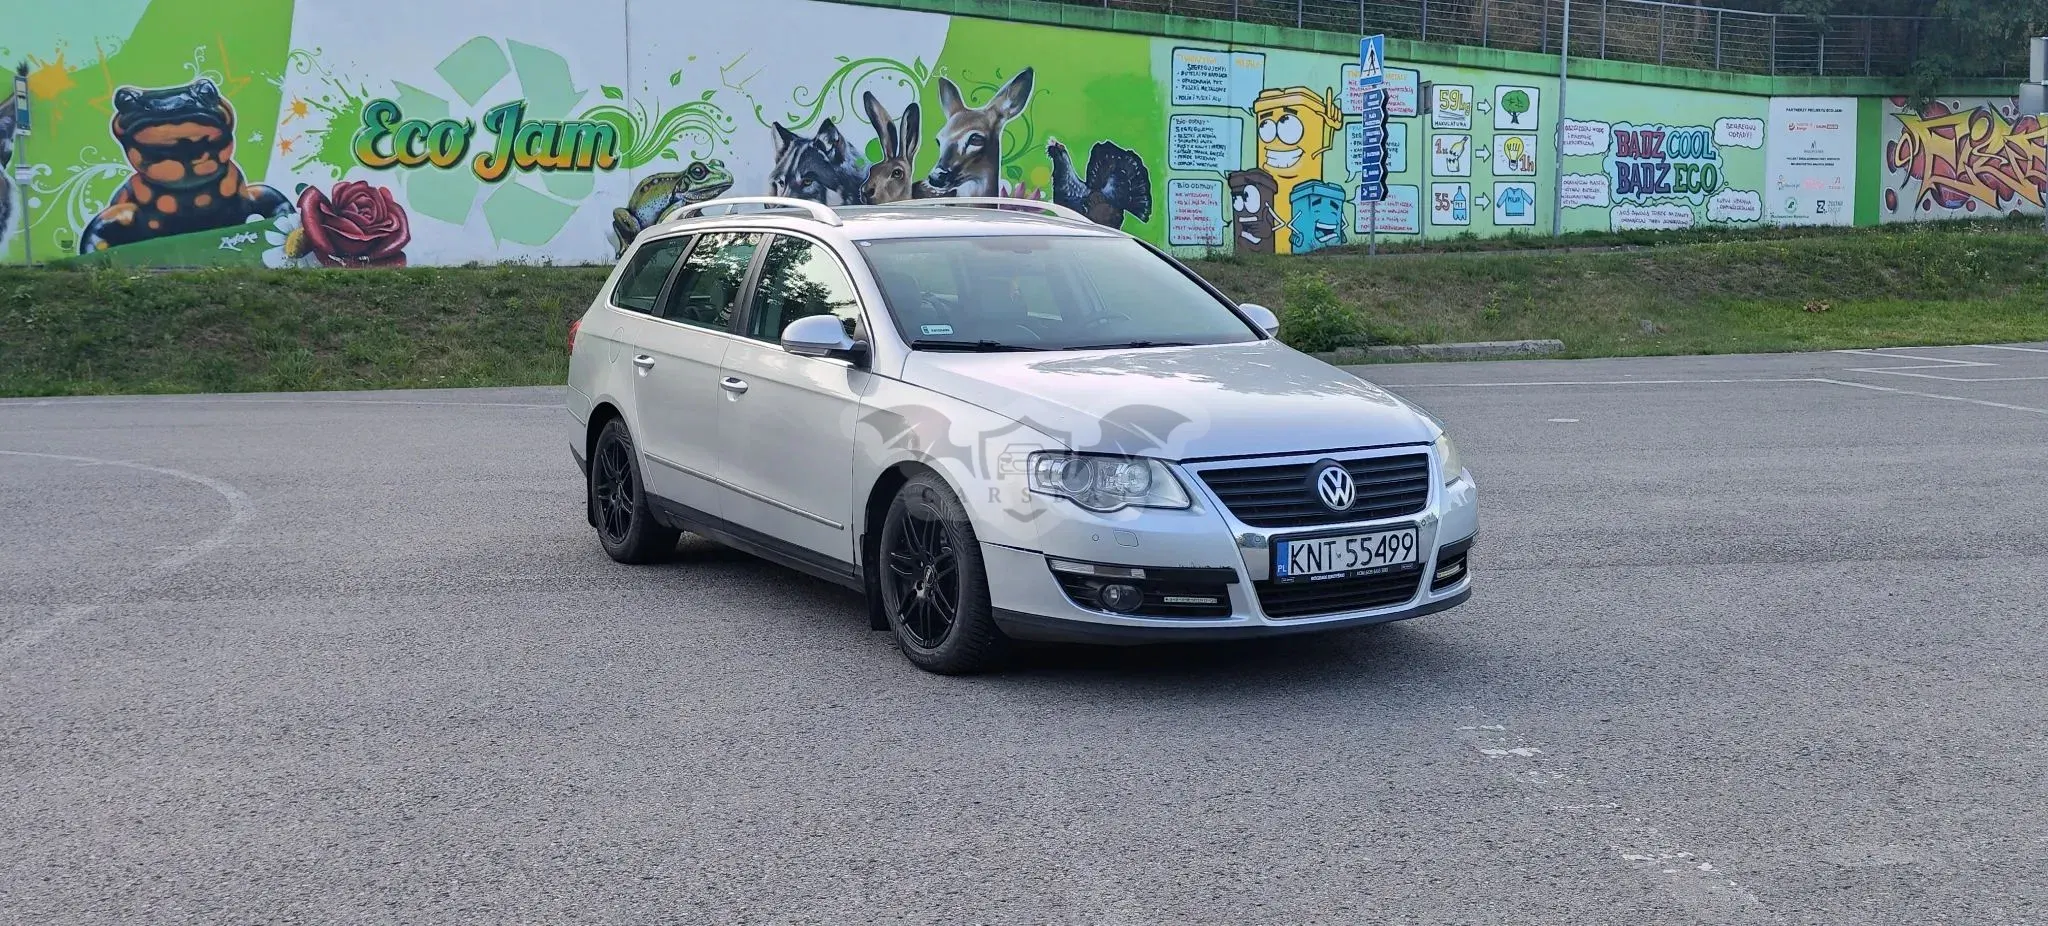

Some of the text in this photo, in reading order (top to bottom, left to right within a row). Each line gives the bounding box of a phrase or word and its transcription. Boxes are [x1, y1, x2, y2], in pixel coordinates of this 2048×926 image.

[354, 98, 621, 183] Eco Jam
[1614, 127, 1717, 161] BĄDŹ COOL
[1615, 158, 1718, 200] BĄDŹ ECO
[1277, 532, 1414, 574] PL KNT 55499
